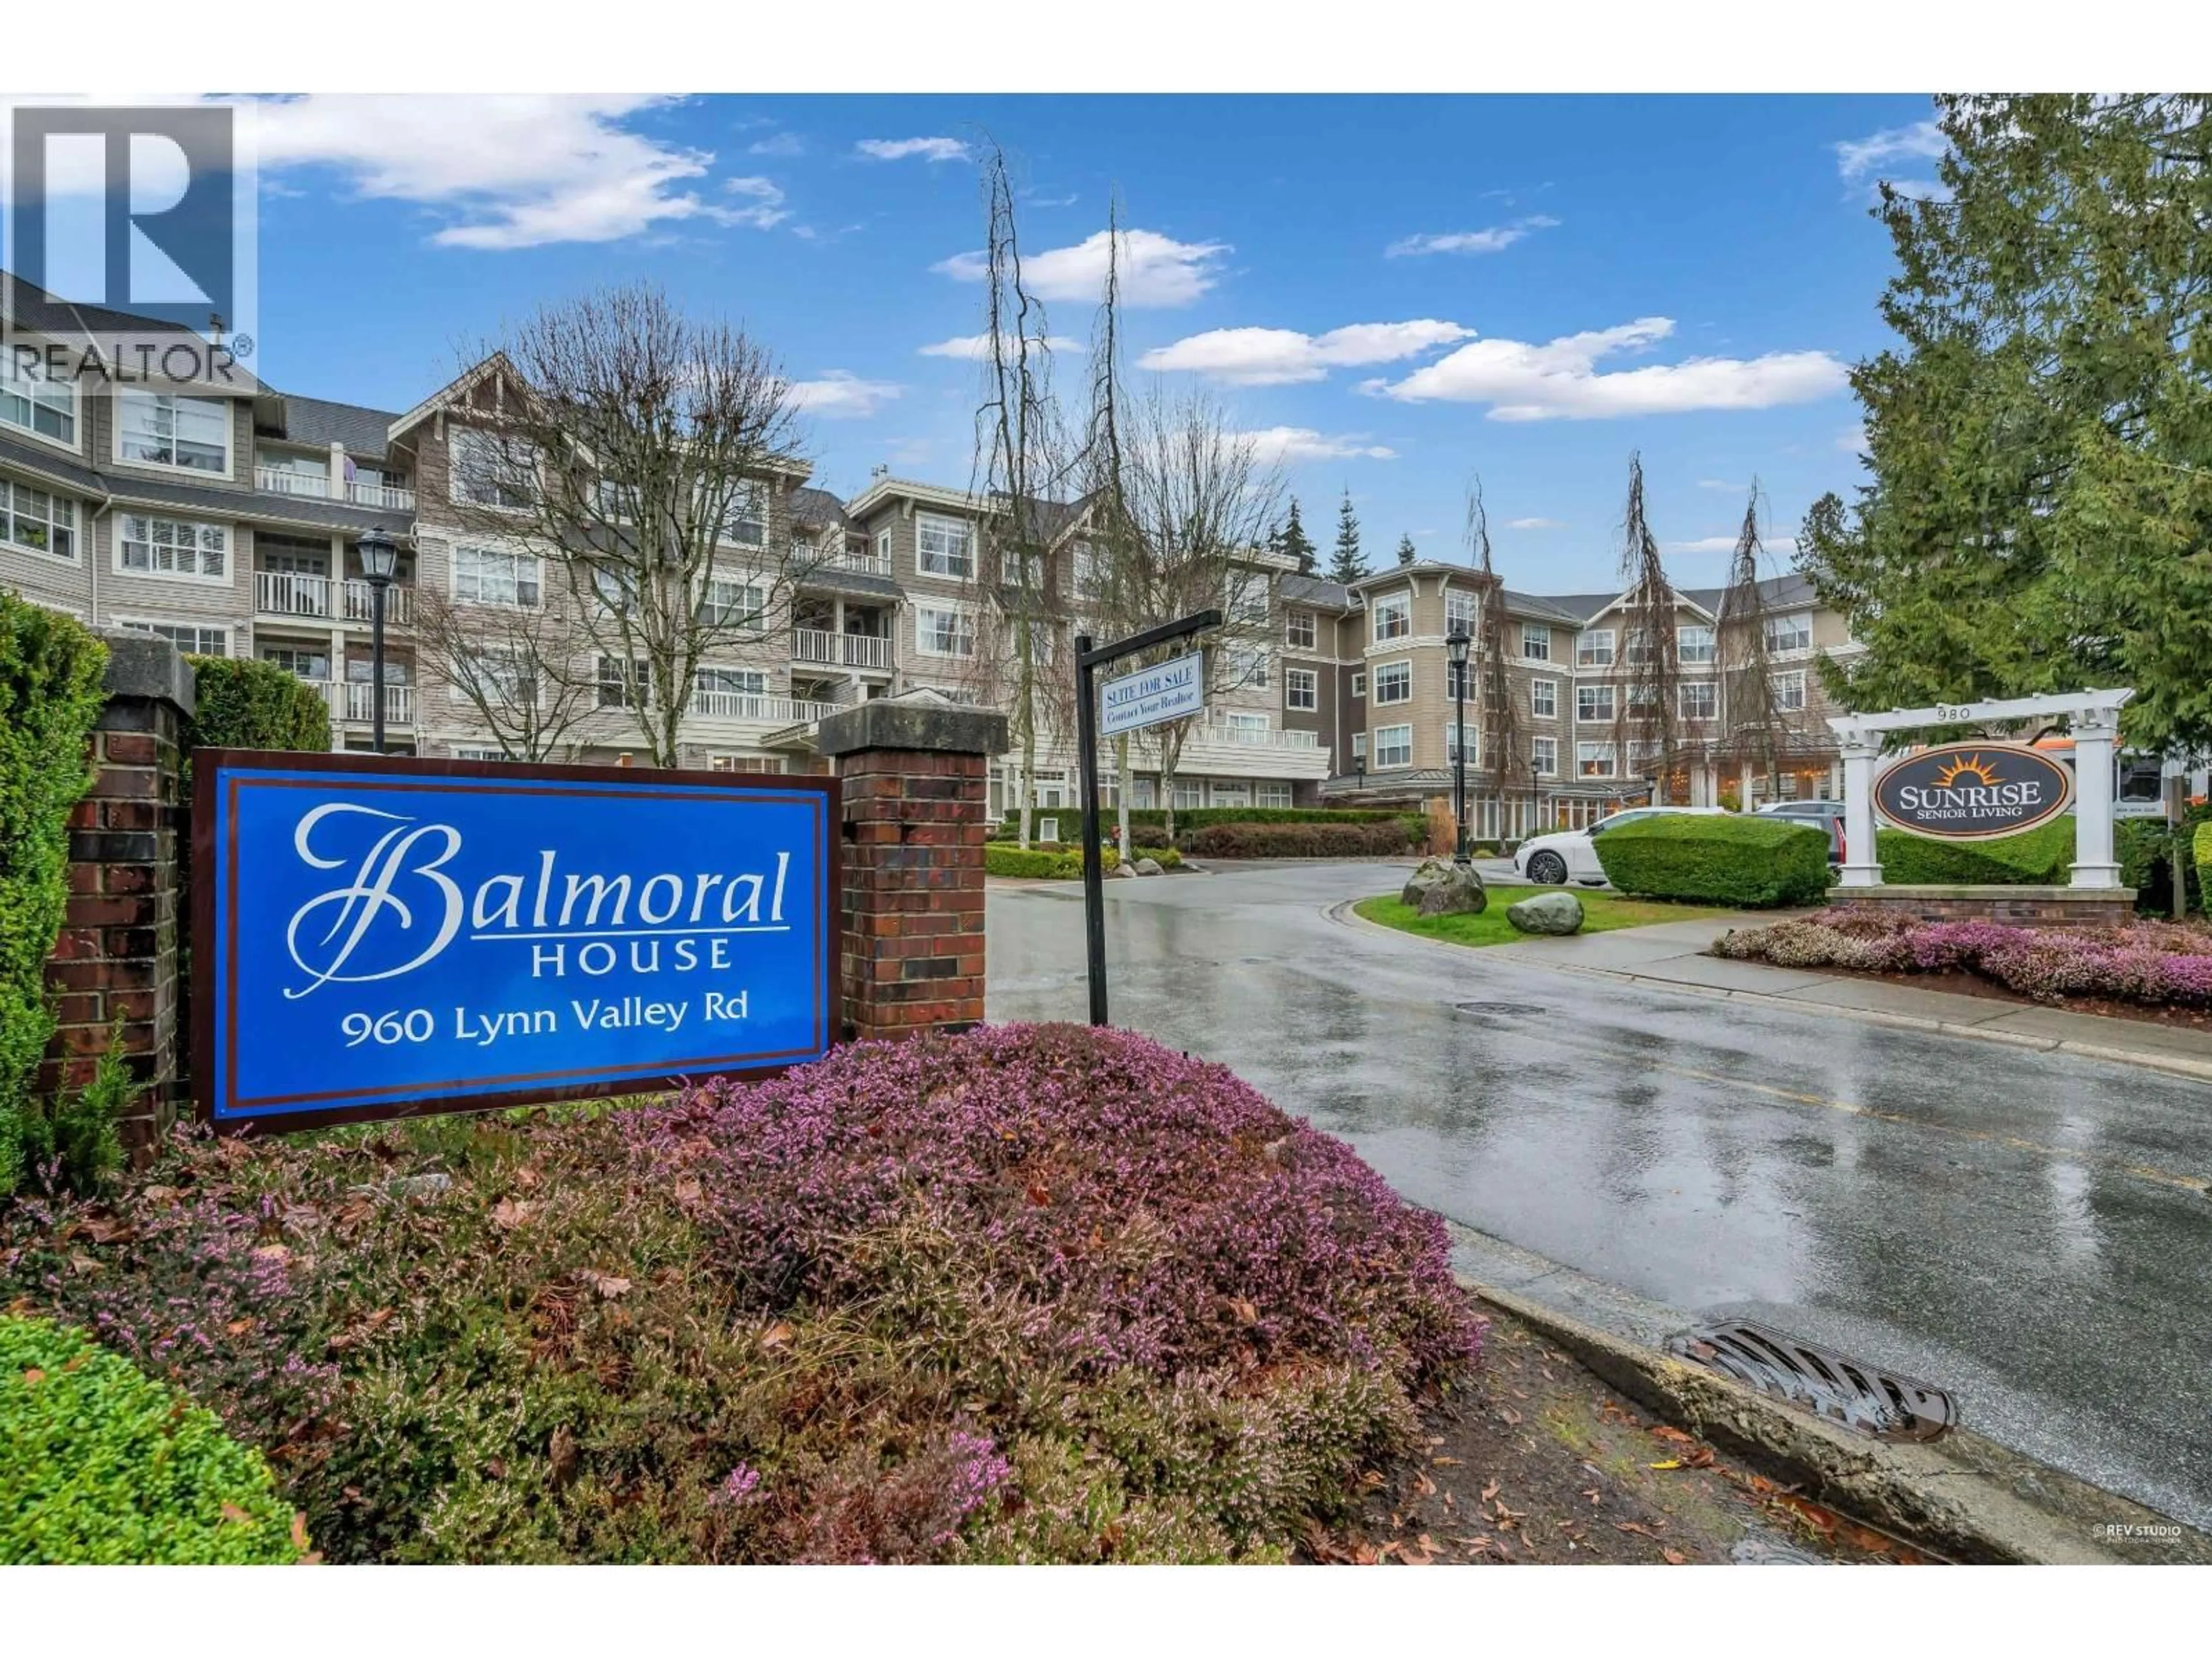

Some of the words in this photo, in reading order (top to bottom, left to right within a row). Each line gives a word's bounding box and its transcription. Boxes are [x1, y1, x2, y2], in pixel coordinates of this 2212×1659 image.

[1107, 684, 1136, 706] SUITE
[1140, 677, 1160, 696] FOR
[1165, 666, 1194, 687] SALE
[1107, 706, 1137, 724] Contact
[1139, 700, 1159, 715] Your
[1161, 691, 1194, 709] Realtor
[1937, 707, 1970, 721] 980
[1899, 781, 2042, 810] SUNRISE
[1916, 807, 1967, 820] SENIOR
[1971, 806, 2023, 819] LIVING
[283, 803, 790, 999] Balmoral
[532, 938, 730, 977] HOUSE
[342, 1009, 434, 1047] 960
[456, 1007, 556, 1046] Lynn
[572, 997, 688, 1032] Valley
[706, 991, 748, 1020] Rd
